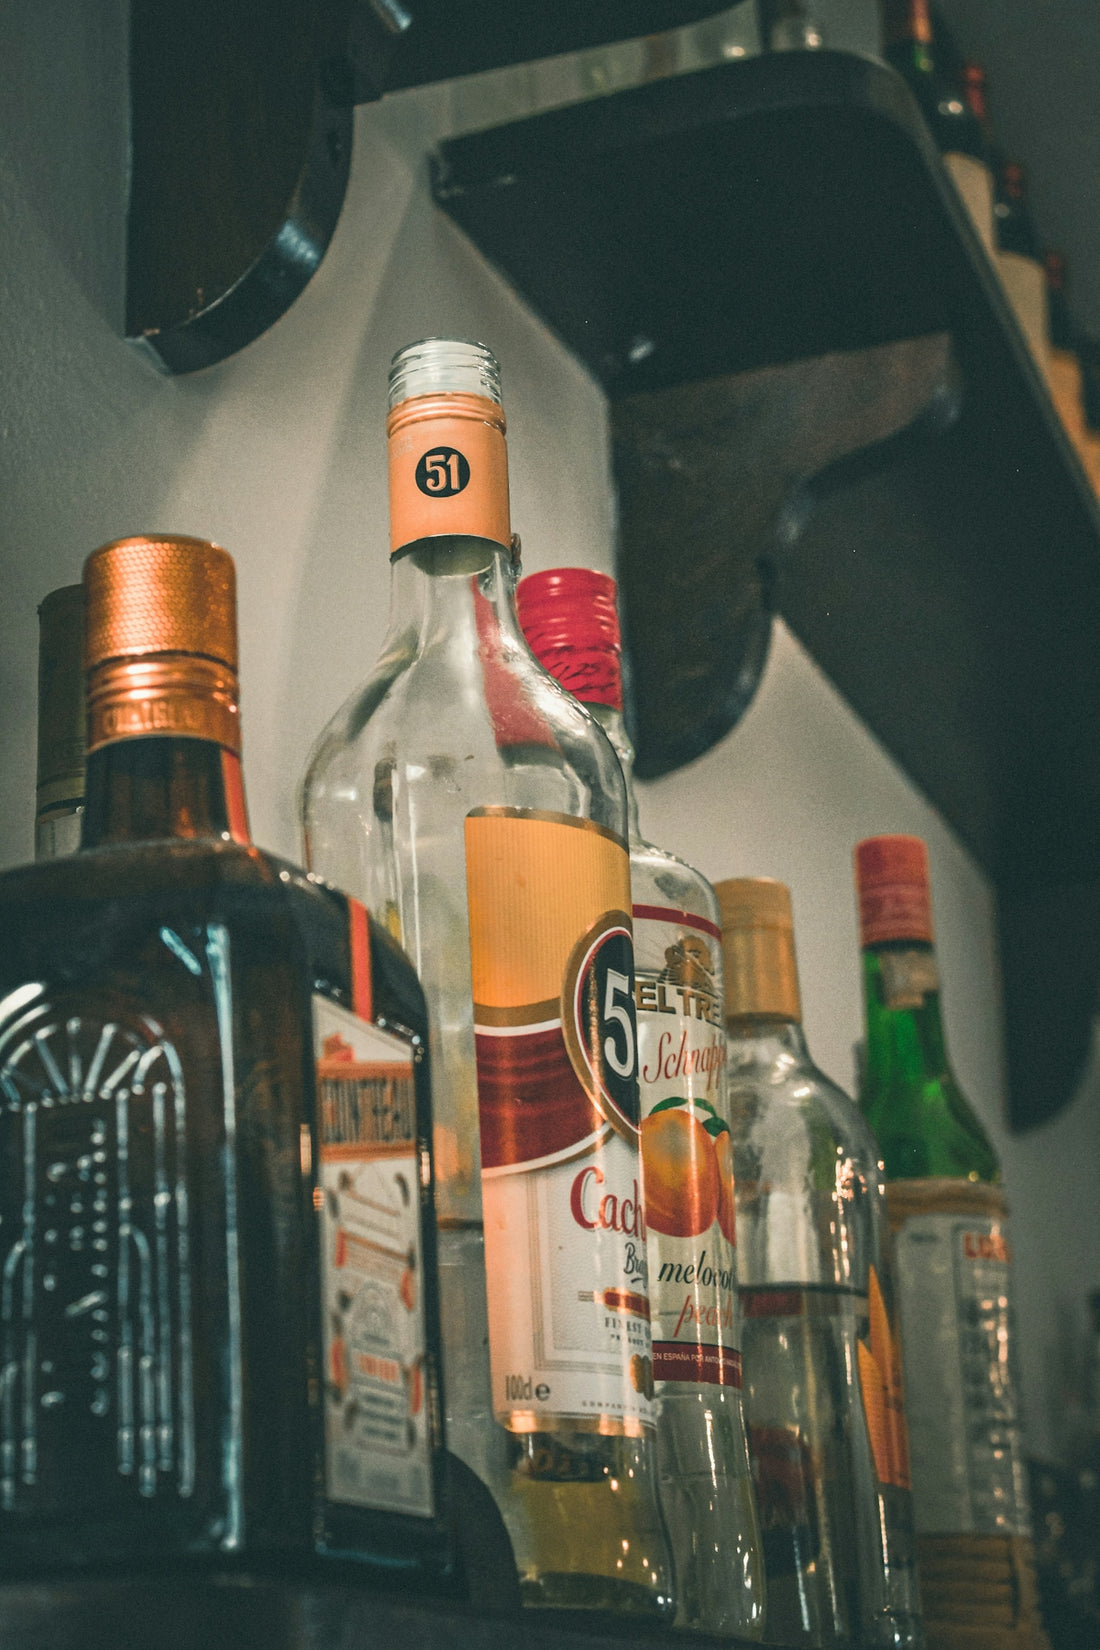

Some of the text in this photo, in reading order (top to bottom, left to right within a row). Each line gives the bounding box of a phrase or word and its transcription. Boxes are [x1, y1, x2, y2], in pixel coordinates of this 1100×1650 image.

[425, 454, 460, 492] 51
[604, 968, 634, 1080] 5
[673, 1295, 732, 1338] peach
[663, 1352, 690, 1361] ESPAÑA
